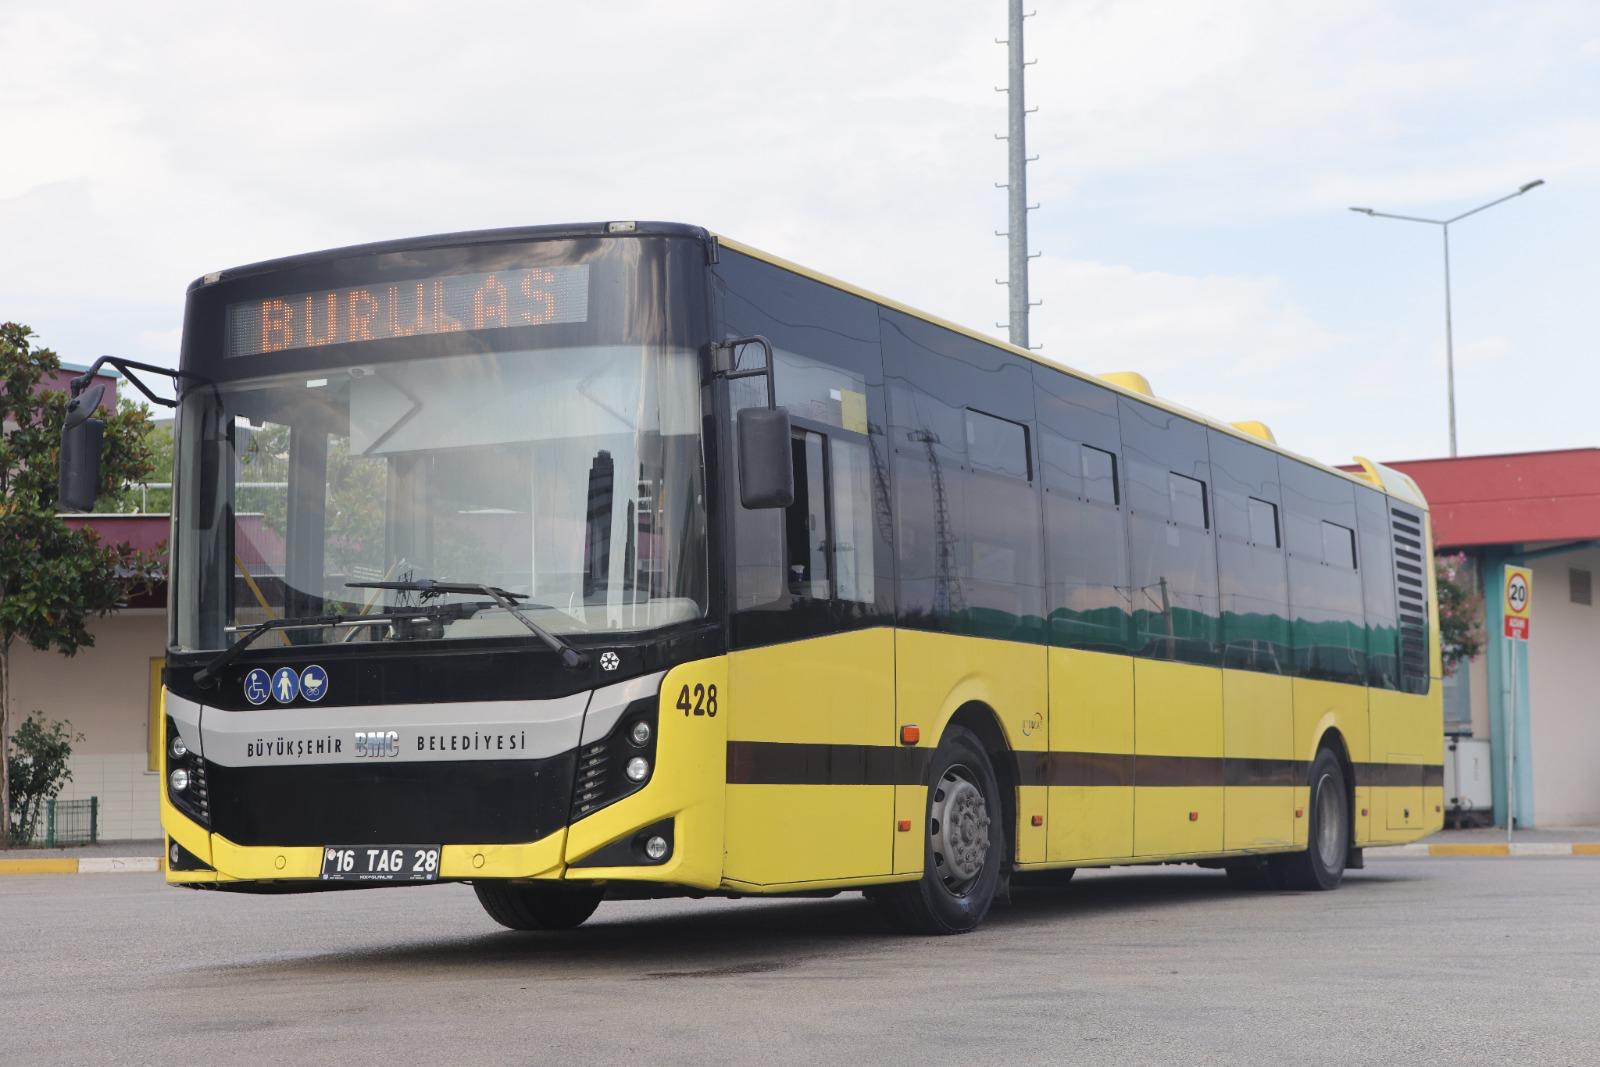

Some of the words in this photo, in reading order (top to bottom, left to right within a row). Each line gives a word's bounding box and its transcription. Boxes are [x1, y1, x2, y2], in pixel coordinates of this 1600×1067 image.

[1511, 584, 1525, 602] 20
[676, 683, 718, 717] 428
[247, 735, 342, 758] BÜYÜKŞEHİR
[354, 731, 399, 757] BMC
[417, 731, 525, 751] BELEDİYESİ
[336, 849, 355, 872] 16
[366, 849, 404, 872] TAG
[412, 849, 437, 872] 28
